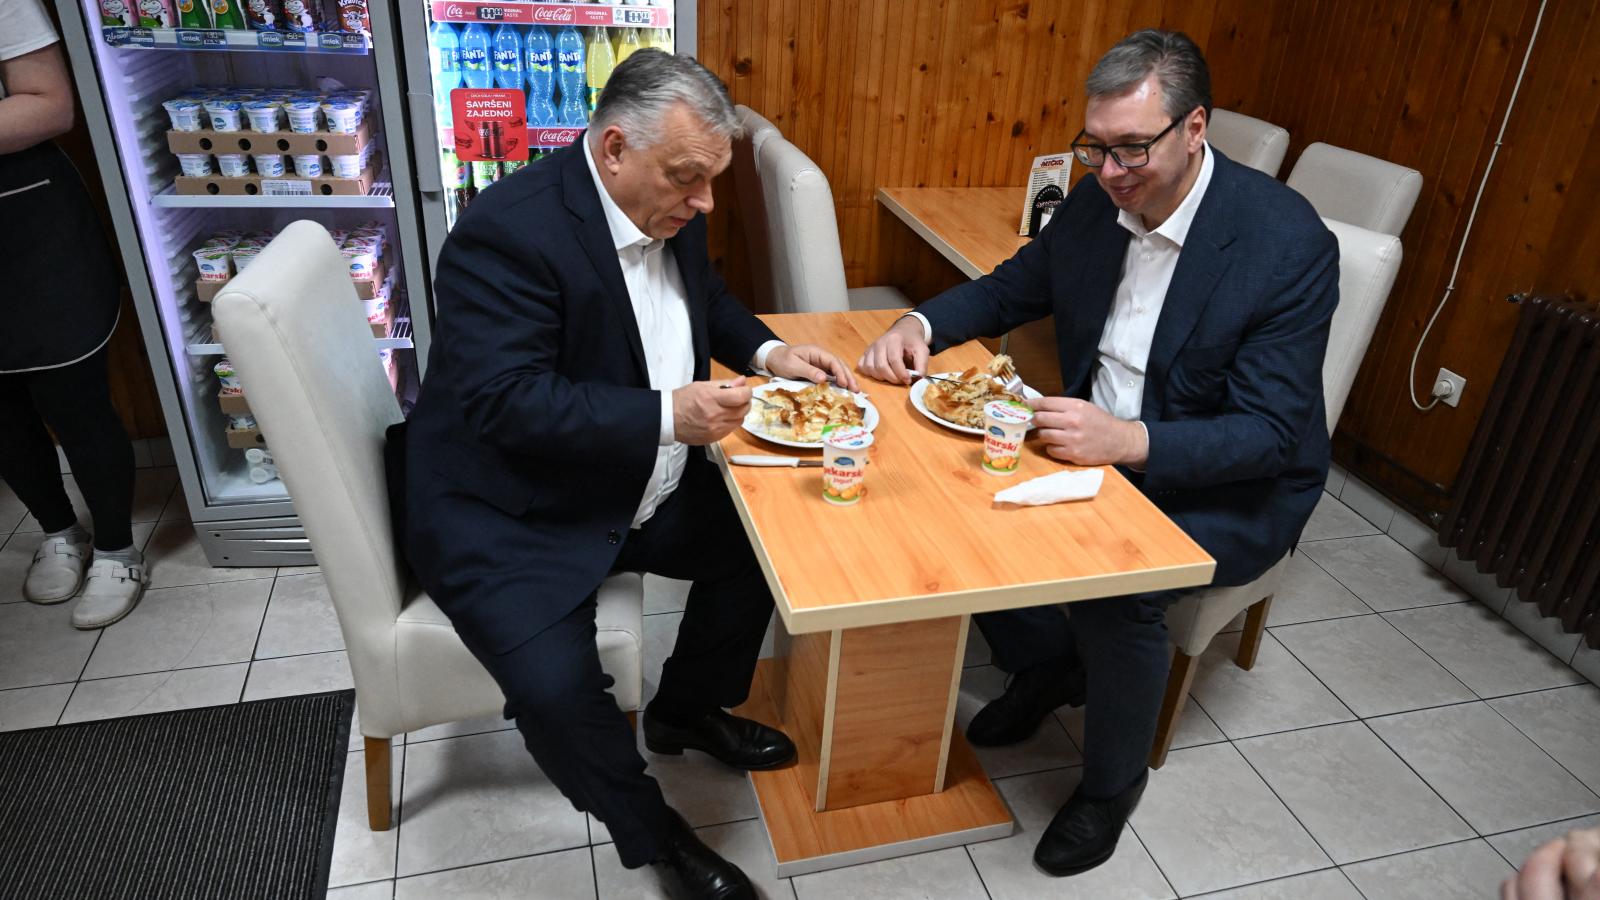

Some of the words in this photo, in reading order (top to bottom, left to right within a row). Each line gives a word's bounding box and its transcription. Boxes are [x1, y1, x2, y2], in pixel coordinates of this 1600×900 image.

[534, 7, 573, 21] Coca-Cola
[465, 99, 512, 108] SAVRŠENI
[466, 109, 513, 117] ZAJEDNO!
[539, 130, 577, 143] Coca-Cola
